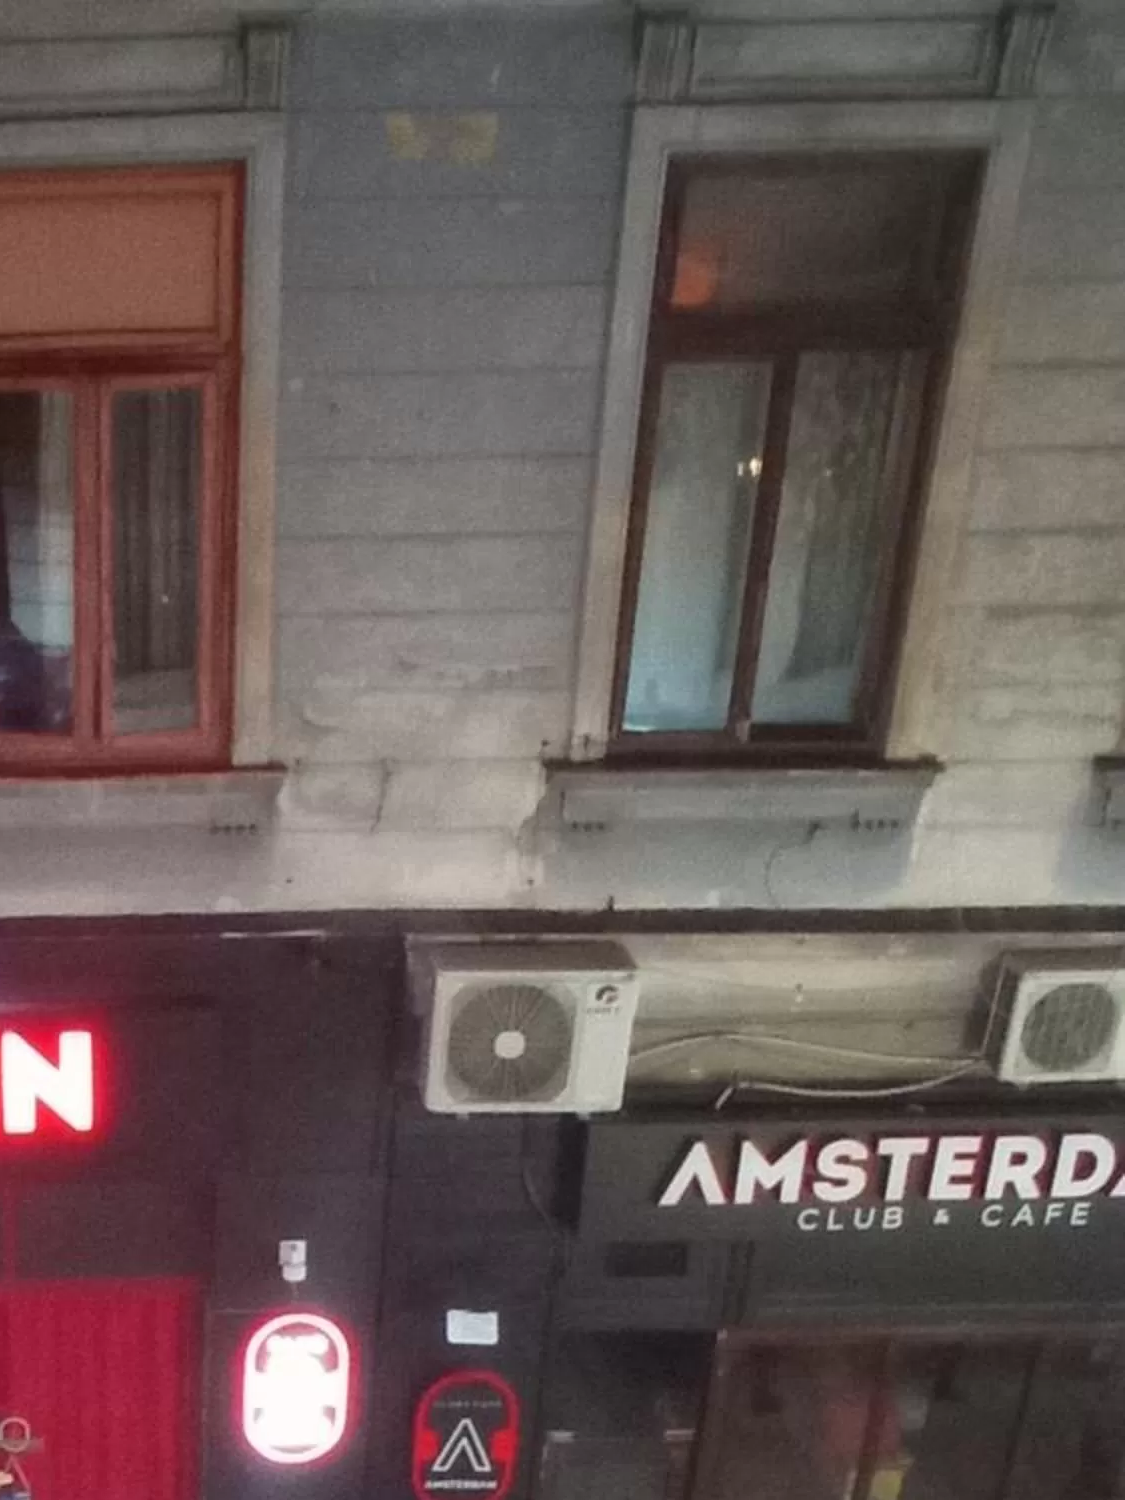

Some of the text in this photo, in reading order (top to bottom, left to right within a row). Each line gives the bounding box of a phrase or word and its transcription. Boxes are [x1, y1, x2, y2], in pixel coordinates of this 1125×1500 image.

[658, 1133, 1125, 1206] AMSTERD
[797, 1202, 1091, 1231] CLUB & CAFE
